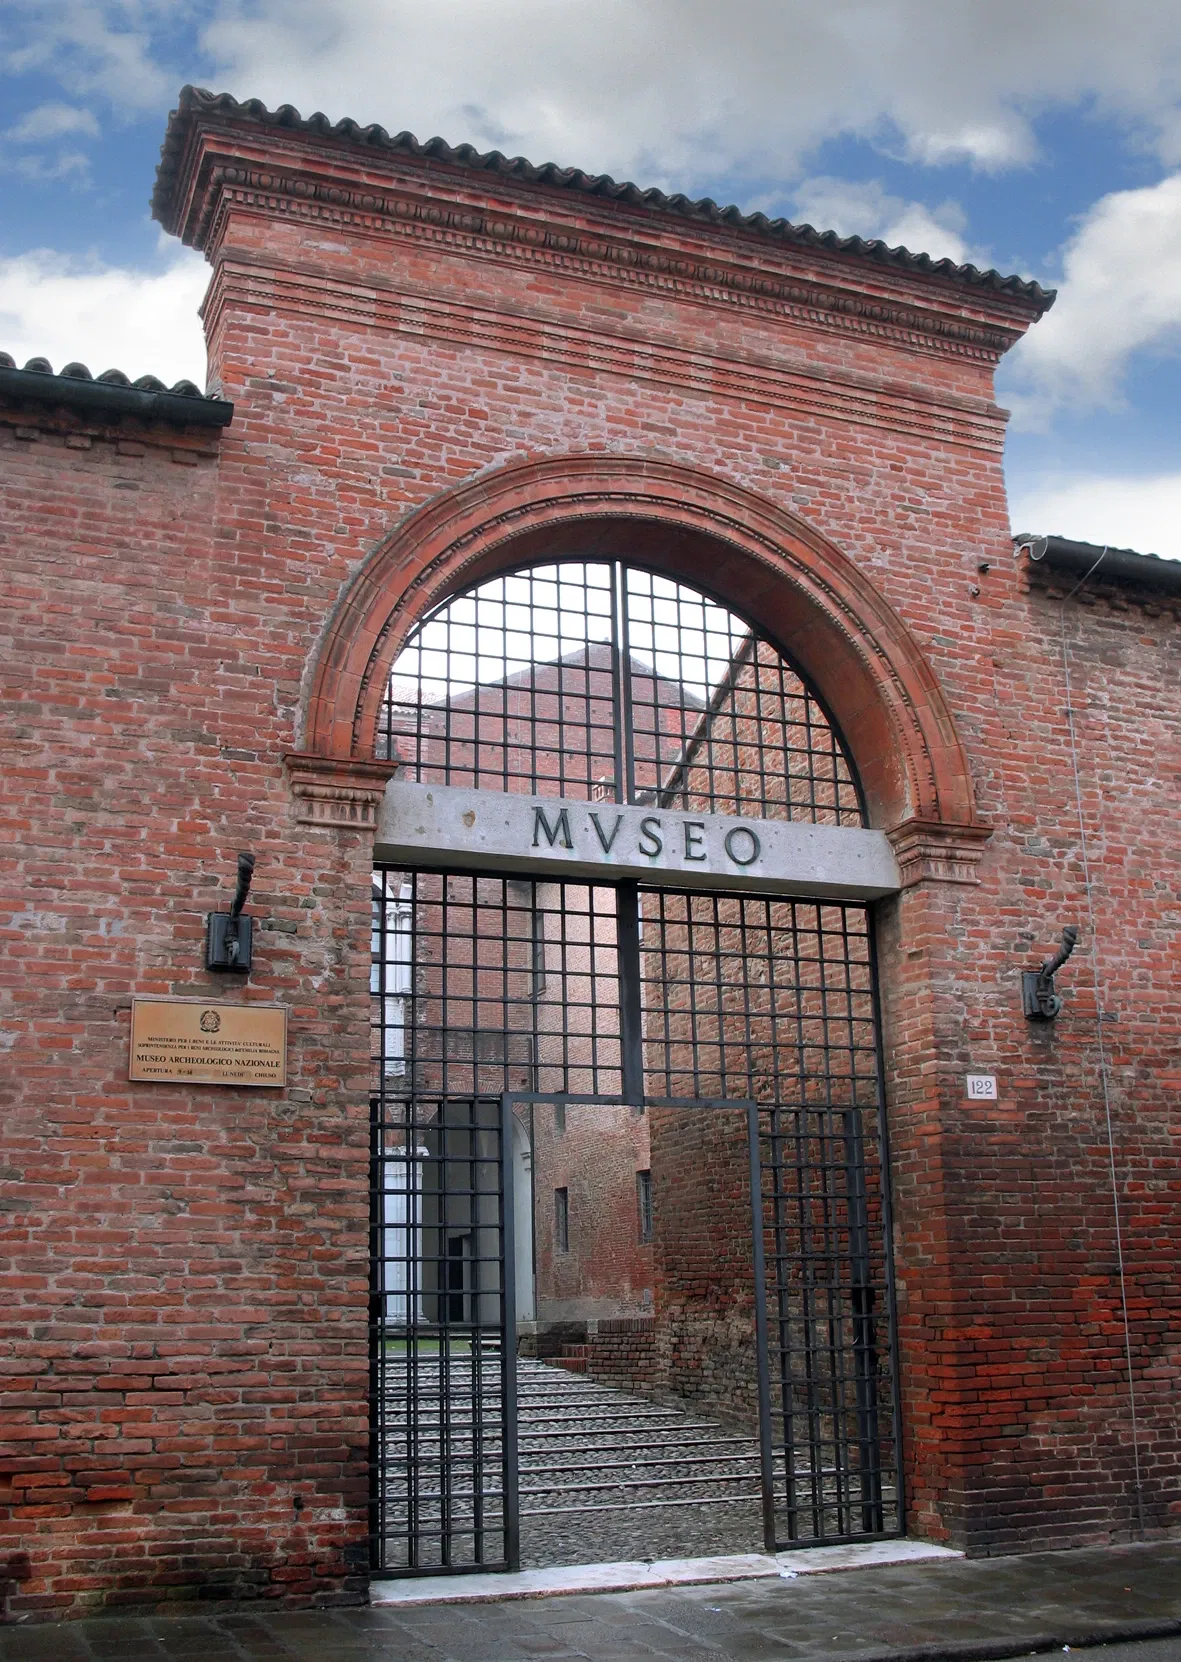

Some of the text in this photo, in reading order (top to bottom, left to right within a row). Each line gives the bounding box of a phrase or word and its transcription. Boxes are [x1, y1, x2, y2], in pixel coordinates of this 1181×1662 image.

[531, 806, 761, 866] MVSEO
[169, 1056, 232, 1065] ARCHEOLOGICO
[971, 1080, 993, 1094] 122
